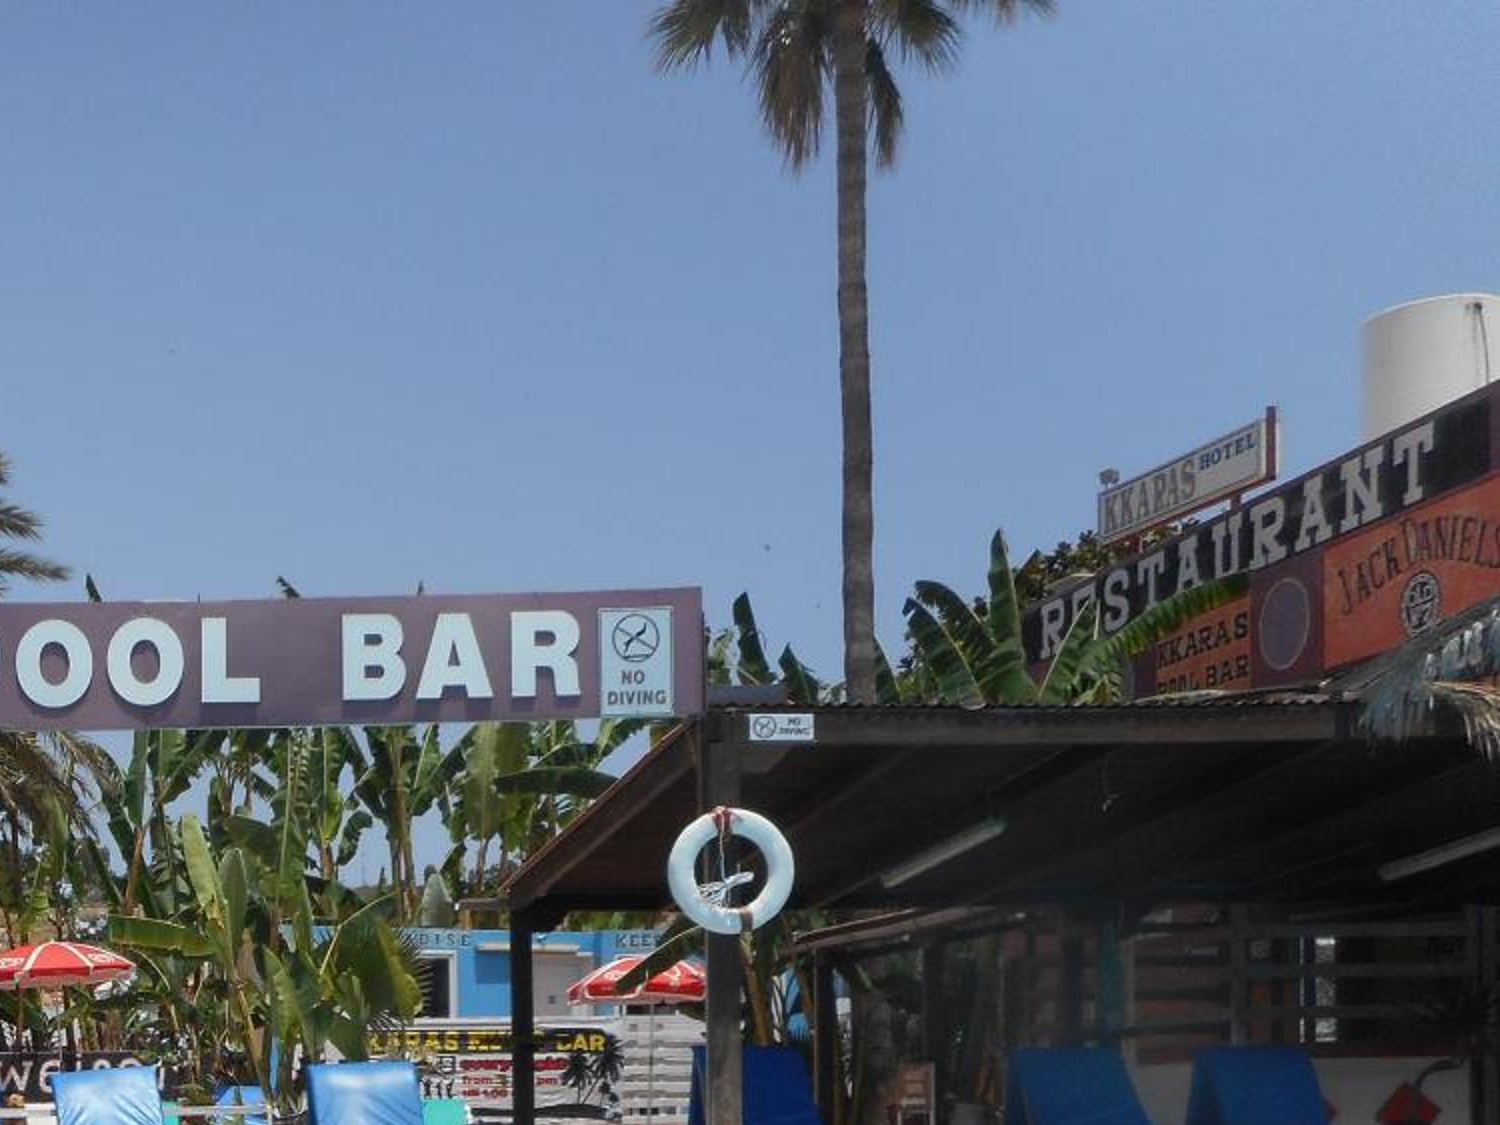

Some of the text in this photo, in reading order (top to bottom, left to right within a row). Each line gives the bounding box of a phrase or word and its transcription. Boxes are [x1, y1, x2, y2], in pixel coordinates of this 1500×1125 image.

[1200, 432, 1255, 470] HOTEL
[1338, 536, 1402, 616] JACK
[342, 609, 582, 703] BAR
[1206, 654, 1249, 689] BAR
[621, 669, 645, 685] NO
[608, 690, 667, 706] DIVING
